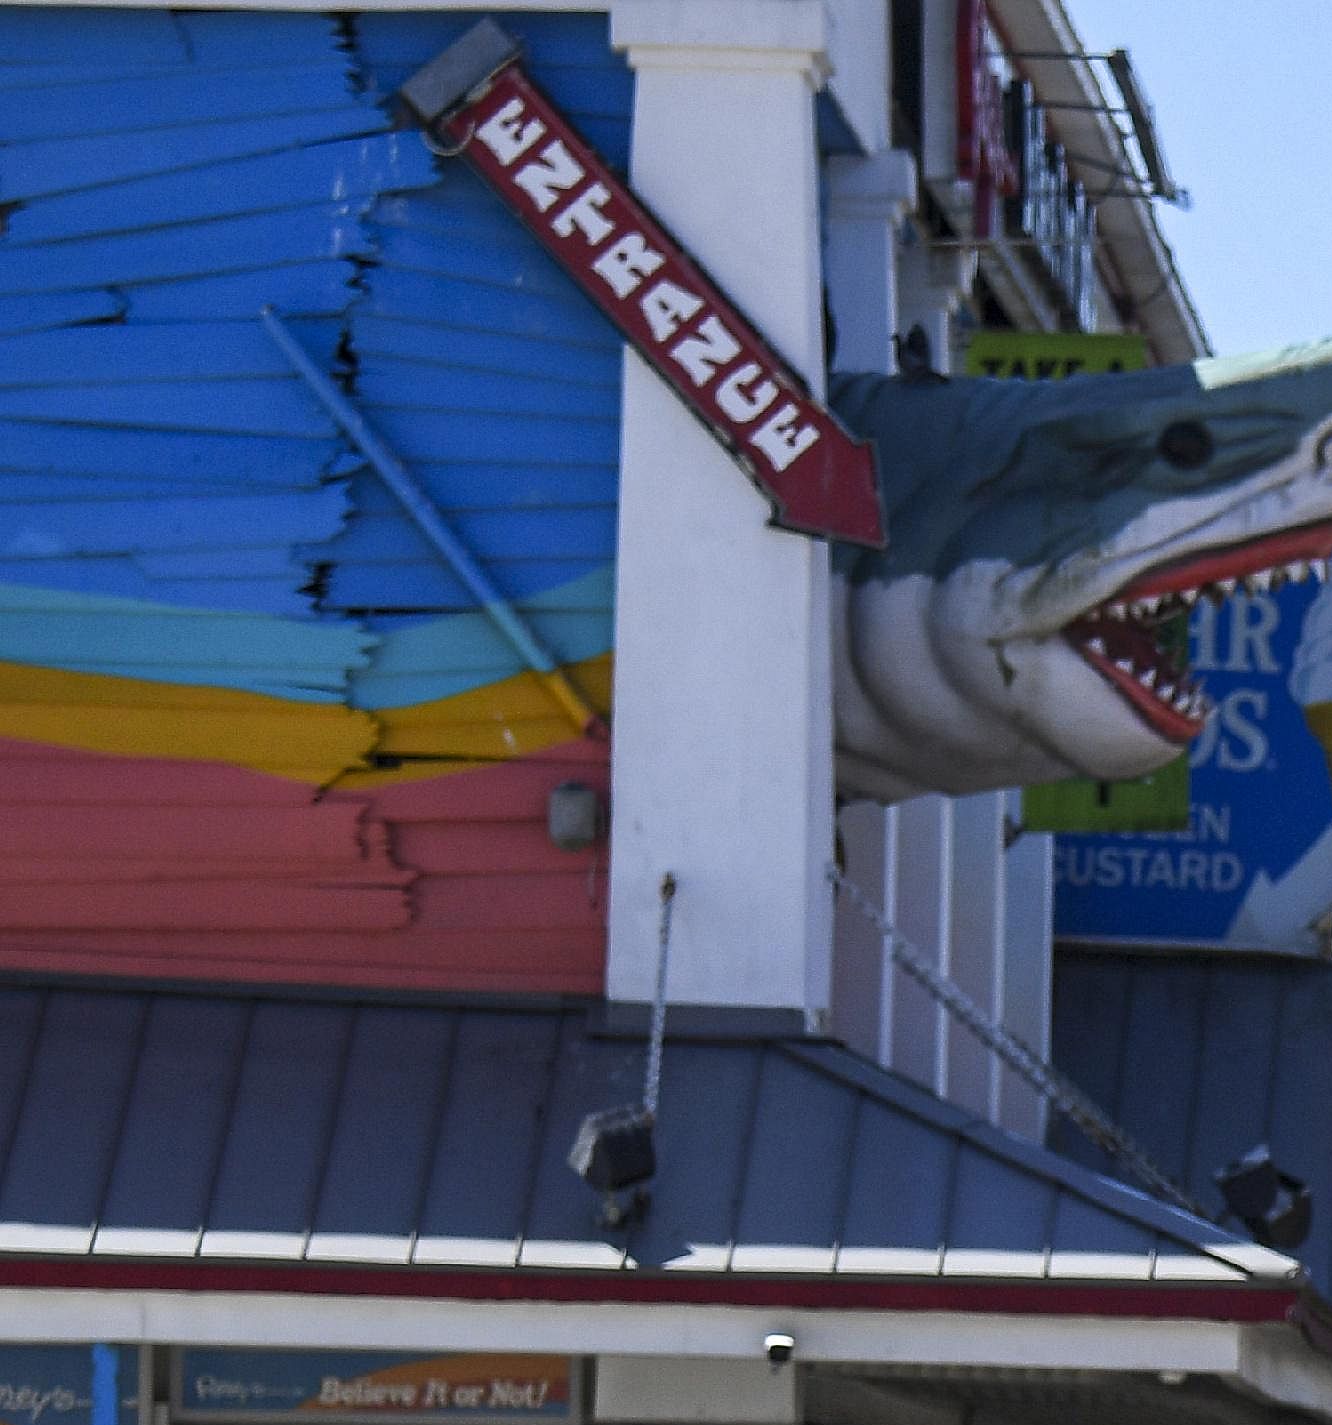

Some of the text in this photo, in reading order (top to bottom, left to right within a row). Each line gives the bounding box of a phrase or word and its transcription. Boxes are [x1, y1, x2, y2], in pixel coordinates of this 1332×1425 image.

[475, 98, 821, 472] ENTRANCE
[321, 1377, 417, 1407] Believe
[426, 1378, 449, 1408] It
[455, 1385, 483, 1408] or
[489, 1378, 549, 1410] Not!
